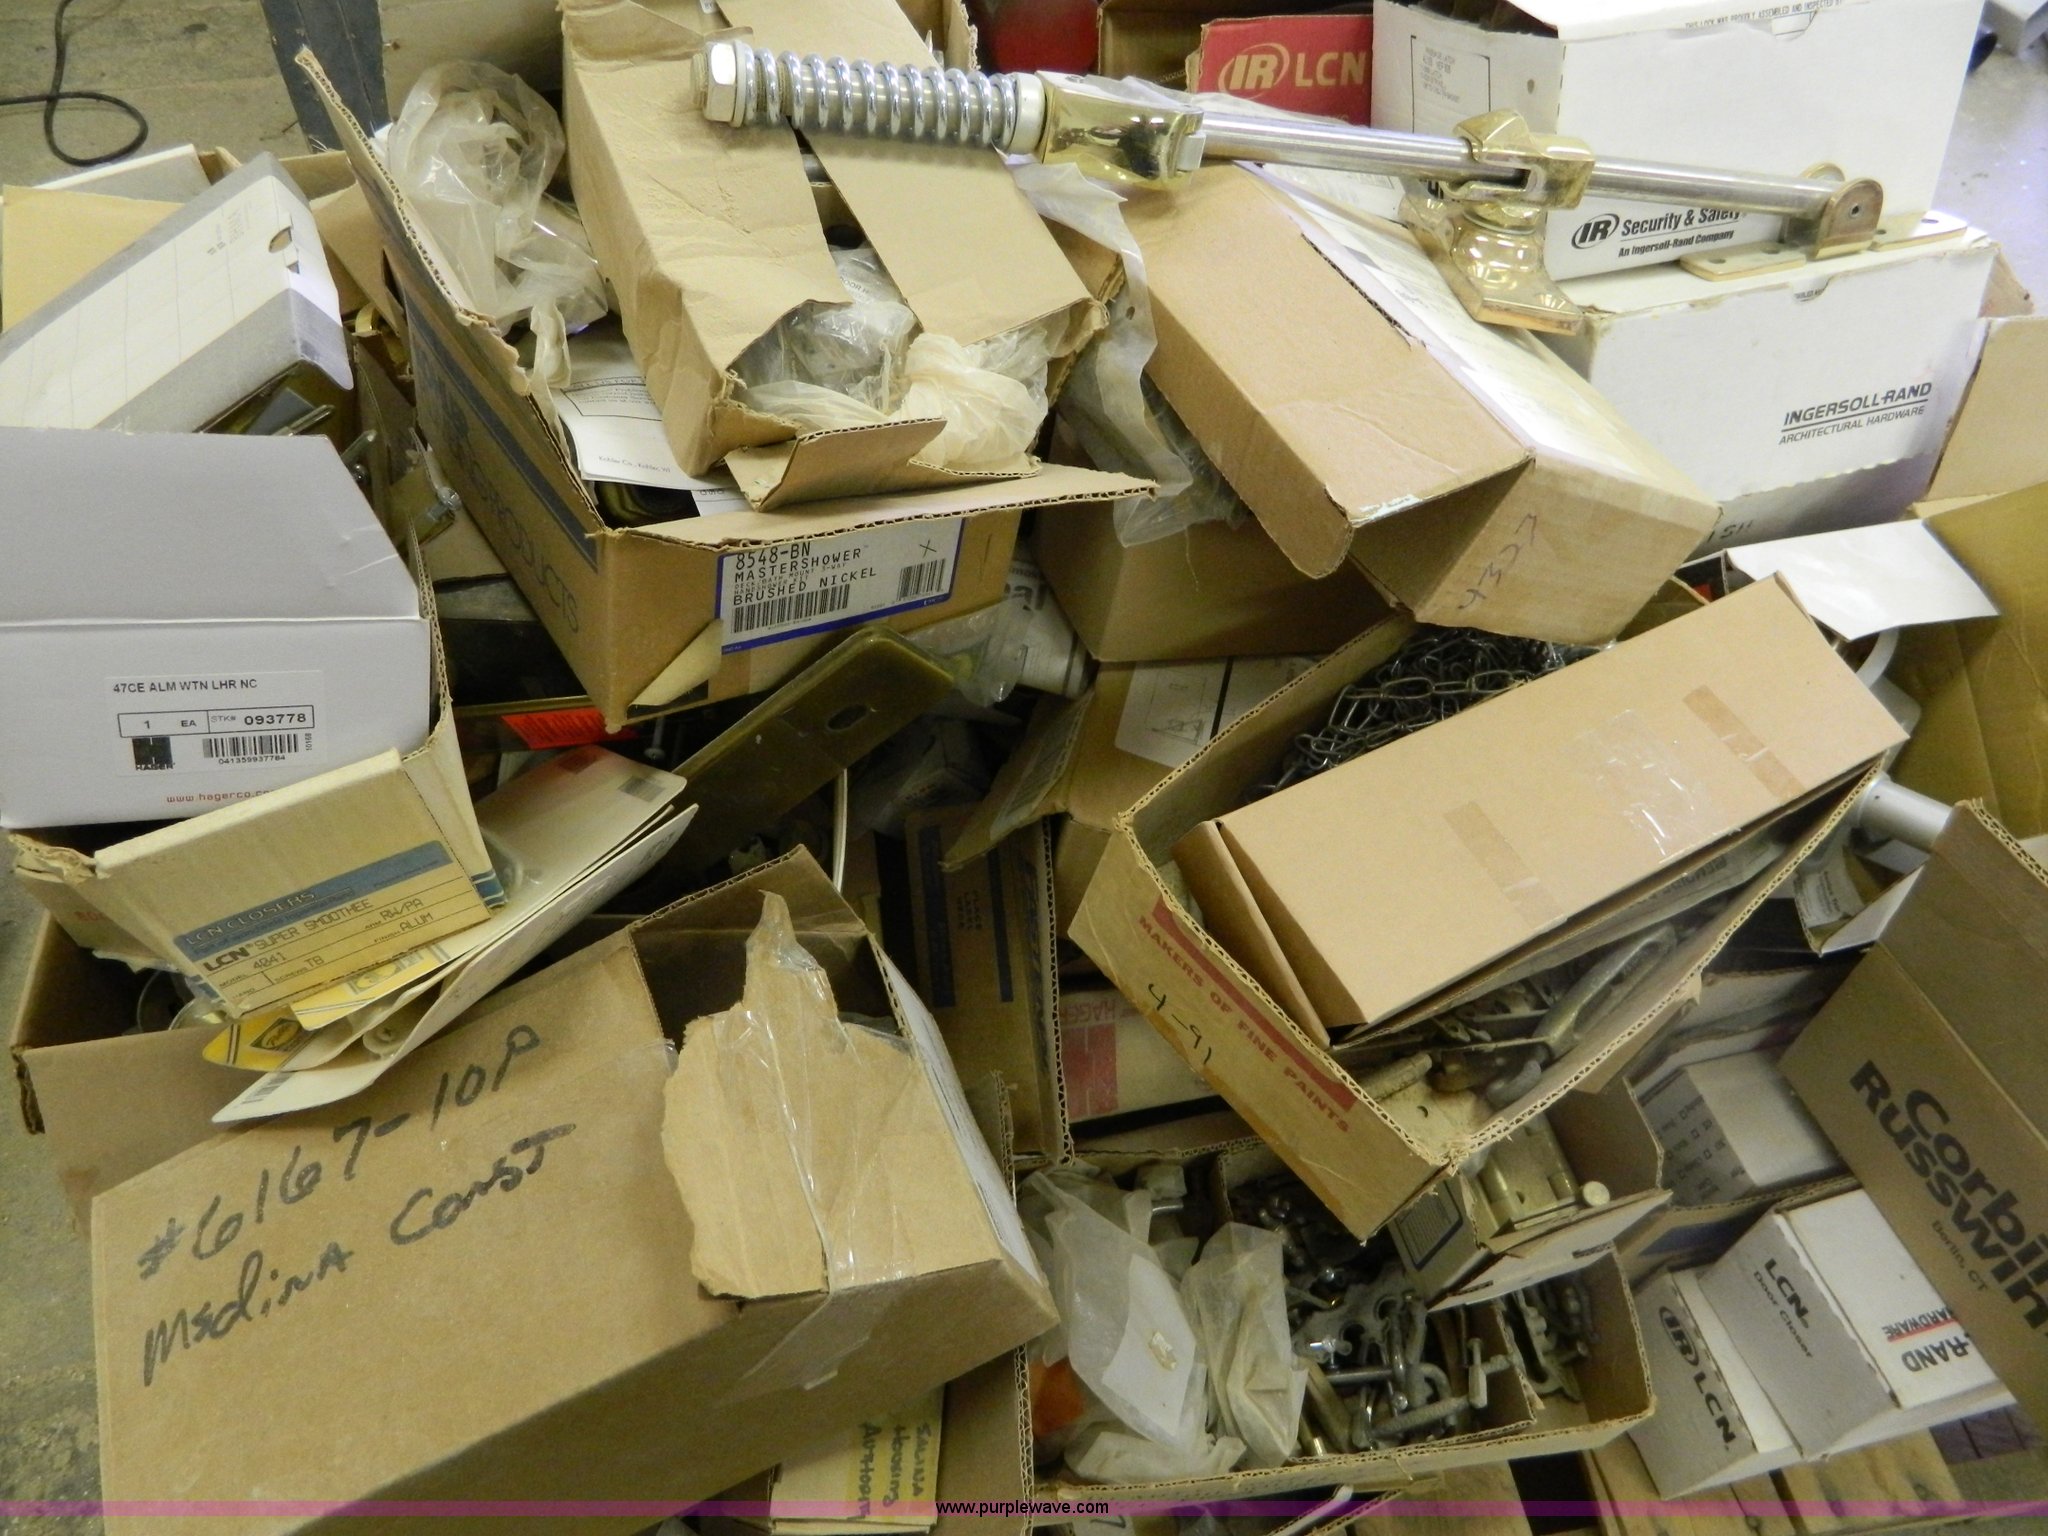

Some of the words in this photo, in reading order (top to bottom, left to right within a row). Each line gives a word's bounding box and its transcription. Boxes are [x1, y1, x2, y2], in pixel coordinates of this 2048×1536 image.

[1295, 51, 1366, 88] LCN
[1621, 213, 1682, 237] Security
[1683, 208, 1695, 227] &
[1618, 248, 1630, 258] An
[1631, 237, 1694, 256] Ingersoll-Rand
[1695, 230, 1735, 244] Company
[1783, 382, 1933, 426] INGERSOLL-RAND
[1779, 418, 1863, 446] ARCHITECTURAL
[1866, 406, 1926, 427] HARDWARE
[735, 541, 811, 571] 8548-BN
[735, 548, 861, 584] MASTERSHOWER
[788, 568, 816, 579] MOUNT
[733, 580, 807, 606] BRUSHED
[819, 567, 877, 588] NICKEL
[113, 682, 146, 693] 47CE
[149, 681, 177, 692] ALM
[180, 680, 208, 691] WTN
[211, 679, 237, 690] LHR
[240, 678, 258, 689] NC
[144, 720, 151, 729] 1
[181, 719, 197, 728] EA
[244, 713, 307, 726] 093778
[226, 892, 317, 930] CLOSERS
[255, 926, 299, 951] SUPER
[303, 898, 372, 931] SMOOTHEE
[252, 952, 287, 970] 4041
[379, 897, 424, 920] RW/PA
[307, 955, 325, 969] TB
[399, 912, 434, 933] ALUM
[1137, 915, 1204, 988] MAKERS
[1210, 990, 1232, 1014] OF
[1237, 1020, 1278, 1063] FINE
[1282, 1066, 1350, 1133] PAINTS
[1850, 1060, 2048, 1330] Russwin
[1763, 1257, 1809, 1321] LCN
[1967, 1269, 1988, 1292] CT
[1753, 1270, 1780, 1306] Door
[1779, 1309, 1813, 1358] Closer
[1693, 1371, 1736, 1442] LCN
